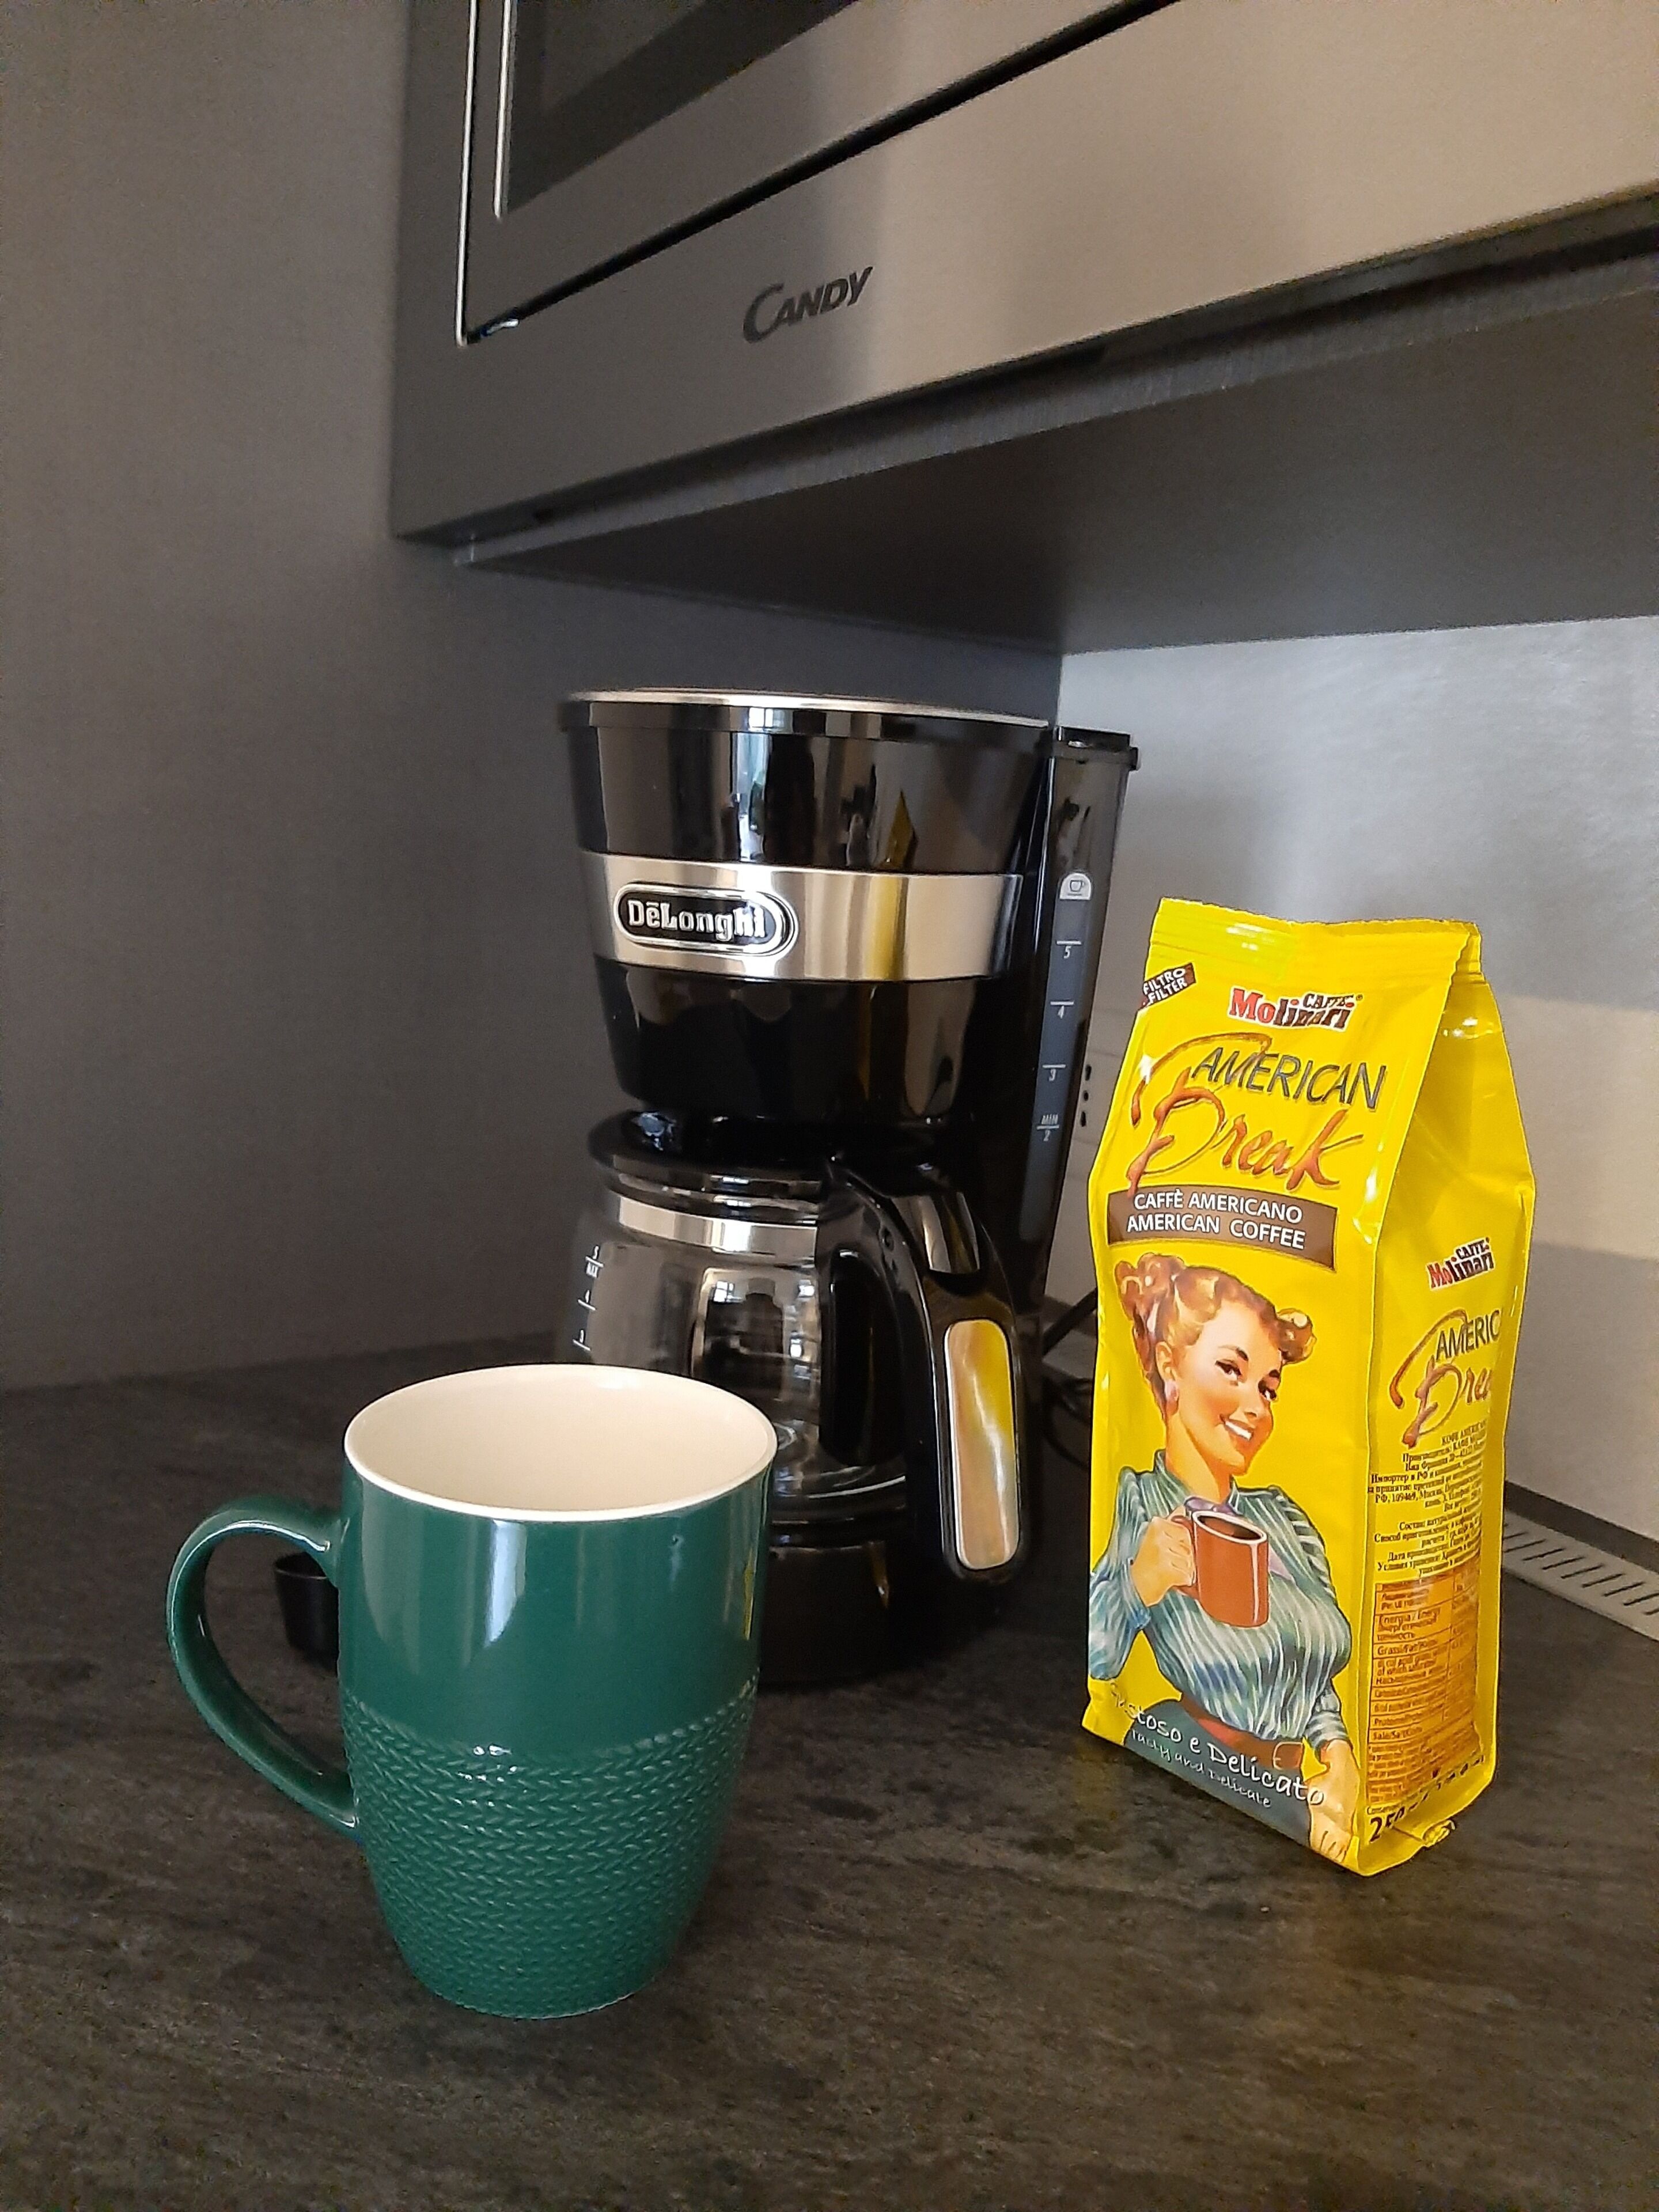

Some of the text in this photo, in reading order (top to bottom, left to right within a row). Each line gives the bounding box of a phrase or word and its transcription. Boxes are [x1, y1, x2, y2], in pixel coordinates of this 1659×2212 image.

[743, 266, 873, 344] CANDY
[1063, 945, 1072, 959] 5
[1143, 968, 1186, 995] FILTRO
[1148, 978, 1187, 1004] FILTER
[1191, 1047, 1387, 1111] AMERICAN
[1126, 1032, 1363, 1197] Break
[1134, 1188, 1302, 1224] CAFFÈ AMERICANO
[1127, 1214, 1306, 1249] AMERICAN COFFEE
[1436, 1310, 1499, 1361] AMERIC
[1190, 1737, 1201, 1753] e
[1207, 1743, 1324, 1805] Delicato
